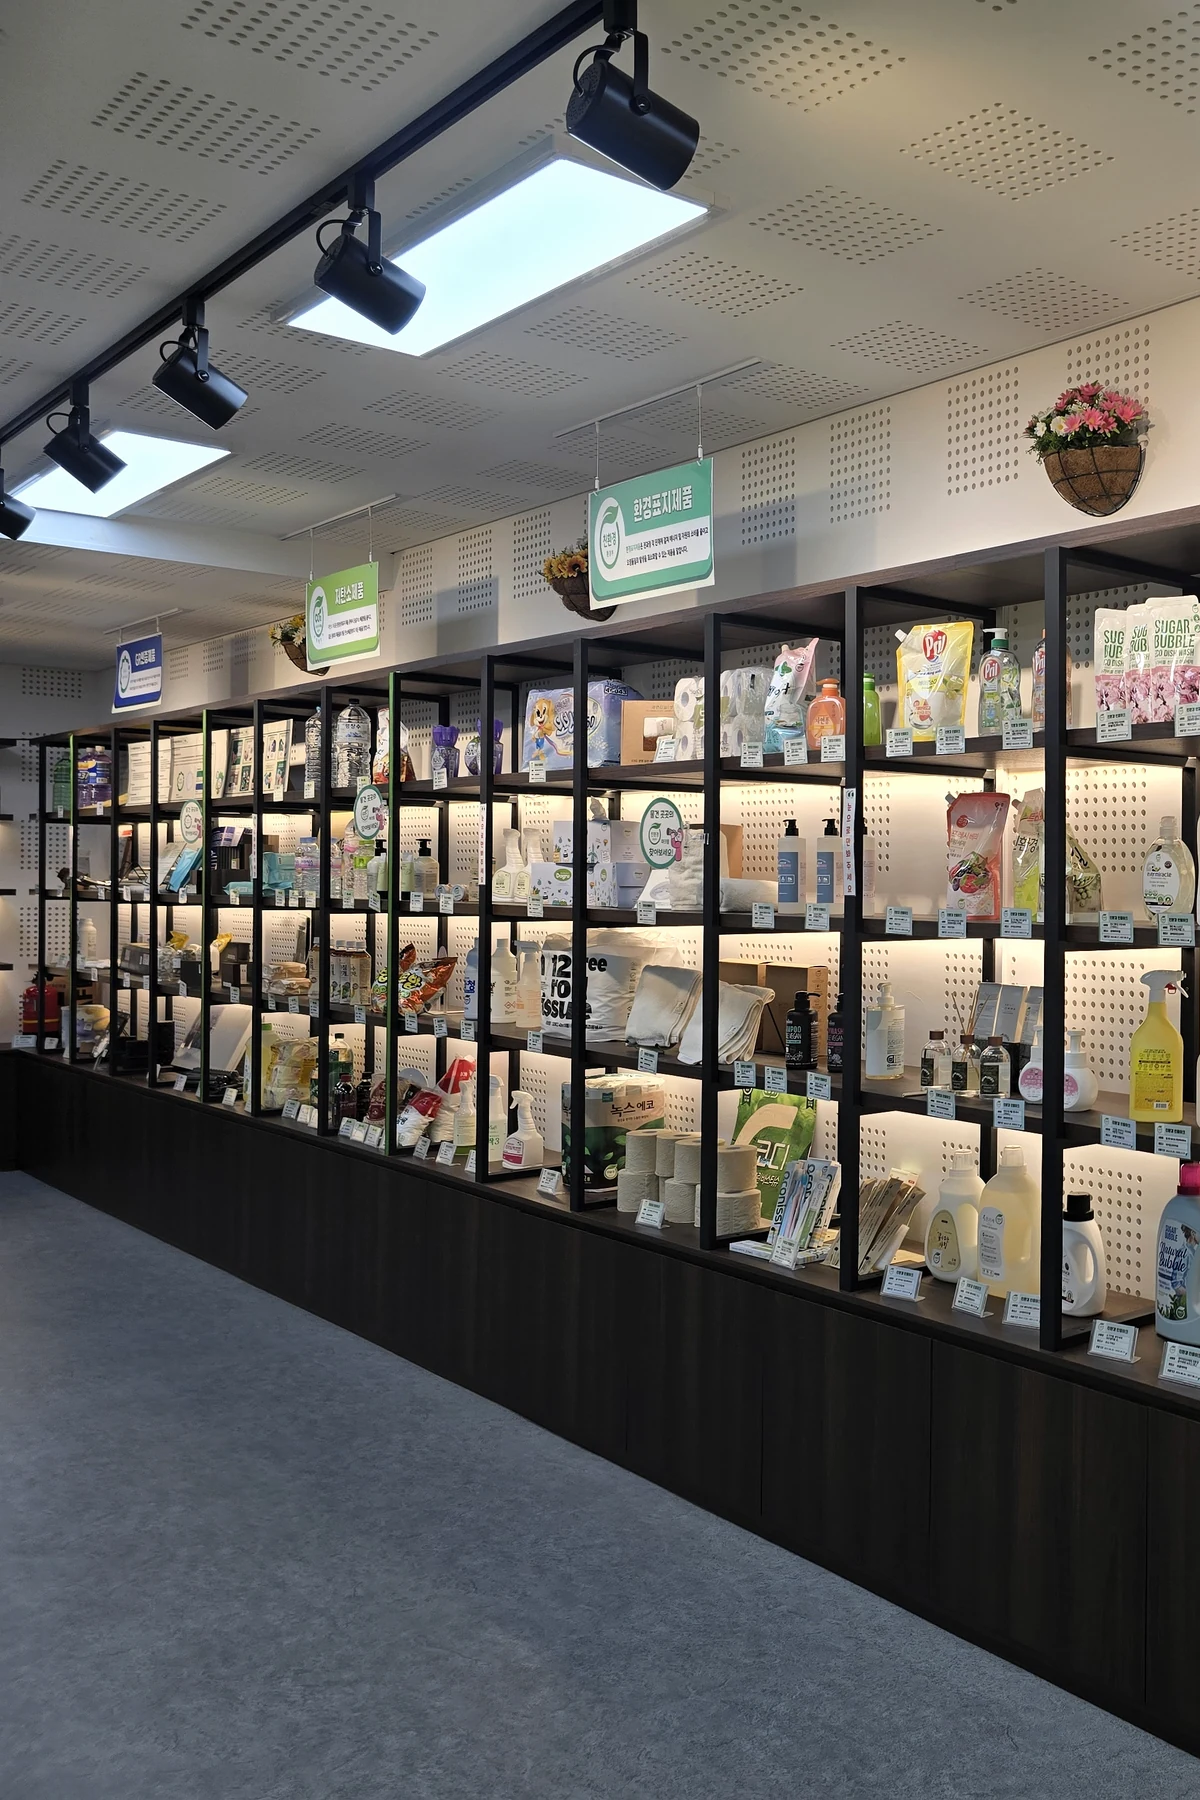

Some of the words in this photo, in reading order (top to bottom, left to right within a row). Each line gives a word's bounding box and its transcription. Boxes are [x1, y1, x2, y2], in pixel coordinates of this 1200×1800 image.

[633, 485, 692, 523] 환경표지제품
[602, 531, 617, 548] 친환경
[1132, 624, 1147, 639] SUG
[1155, 619, 1190, 634] SUGAR
[1104, 630, 1124, 645] SUG
[1130, 638, 1149, 653] BUB
[1155, 634, 1195, 649] BUBBLE
[925, 635, 946, 657] Pril
[1104, 645, 1123, 658] BUB
[984, 663, 998, 679] Pril
[552, 954, 571, 978] 12
[610, 1102, 636, 1117] 녹스
[636, 1100, 654, 1111] 에코
[1160, 1242, 1188, 1259] Natural
[1159, 1251, 1187, 1272] Bubble
